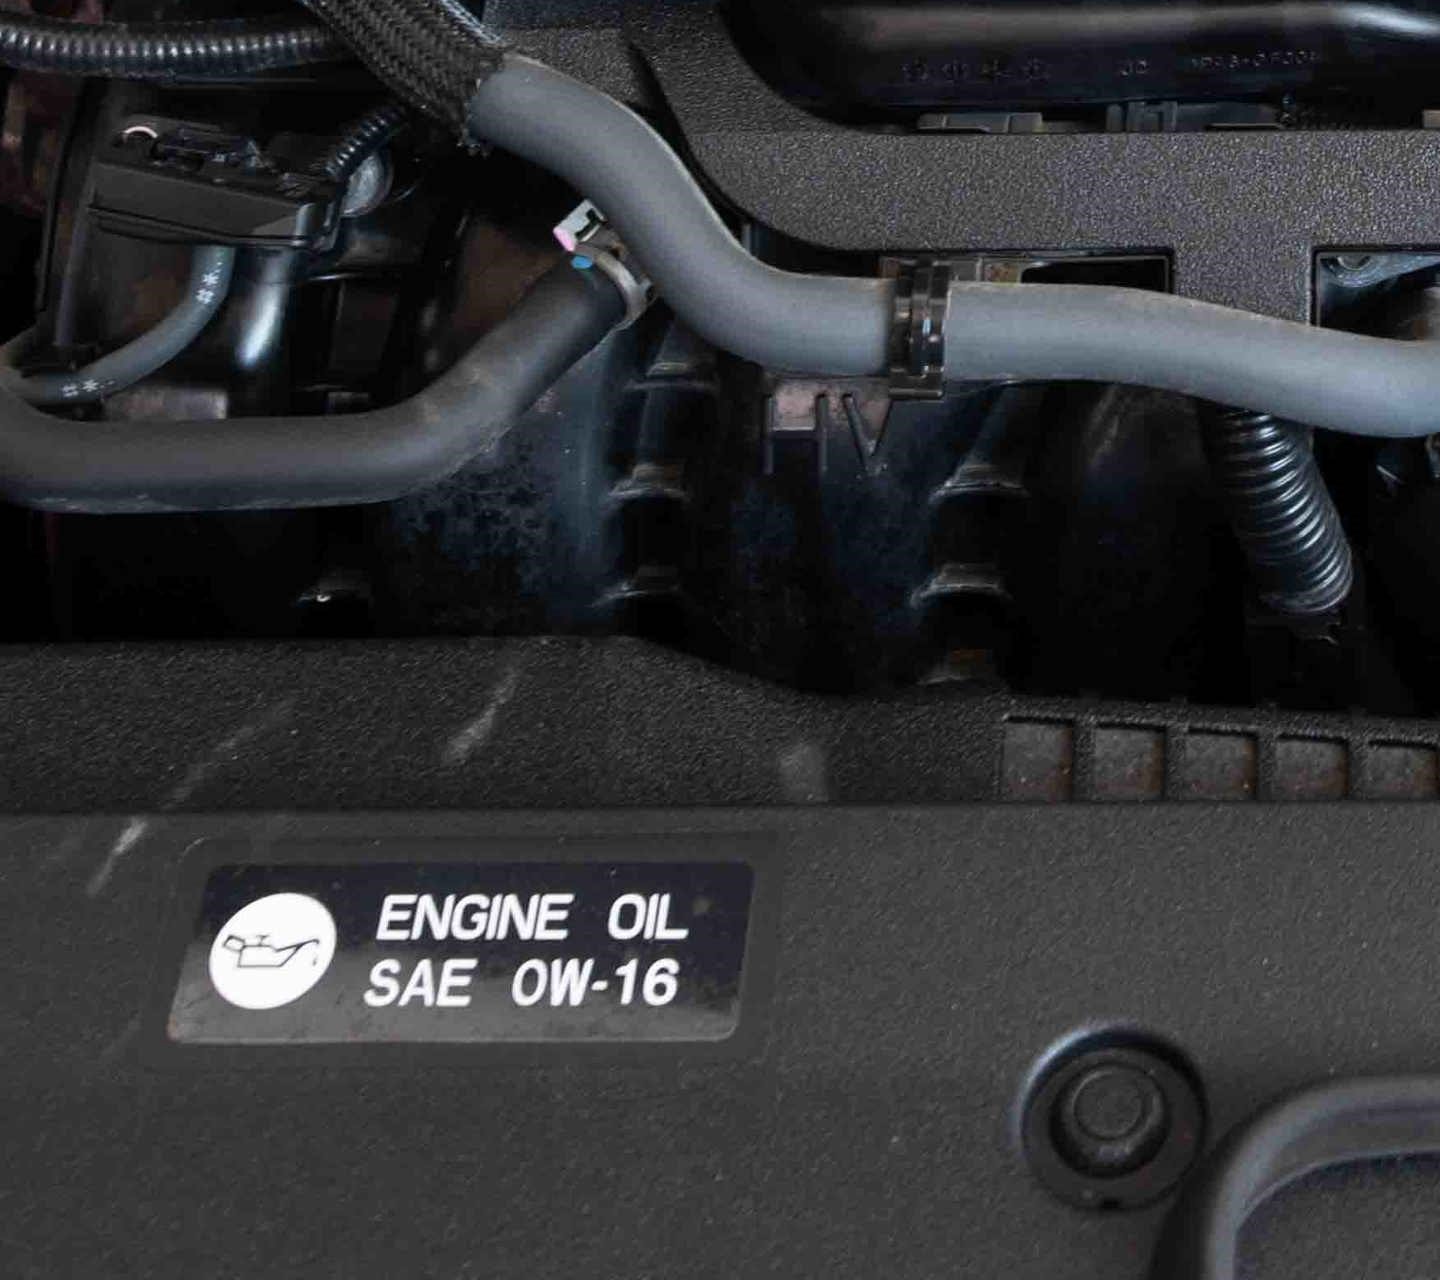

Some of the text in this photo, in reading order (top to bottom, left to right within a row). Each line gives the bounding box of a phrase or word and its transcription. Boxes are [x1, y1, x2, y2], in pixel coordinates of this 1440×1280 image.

[375, 892, 689, 941] ENGINE OIL
[362, 956, 680, 1009] SAE 0W-16
